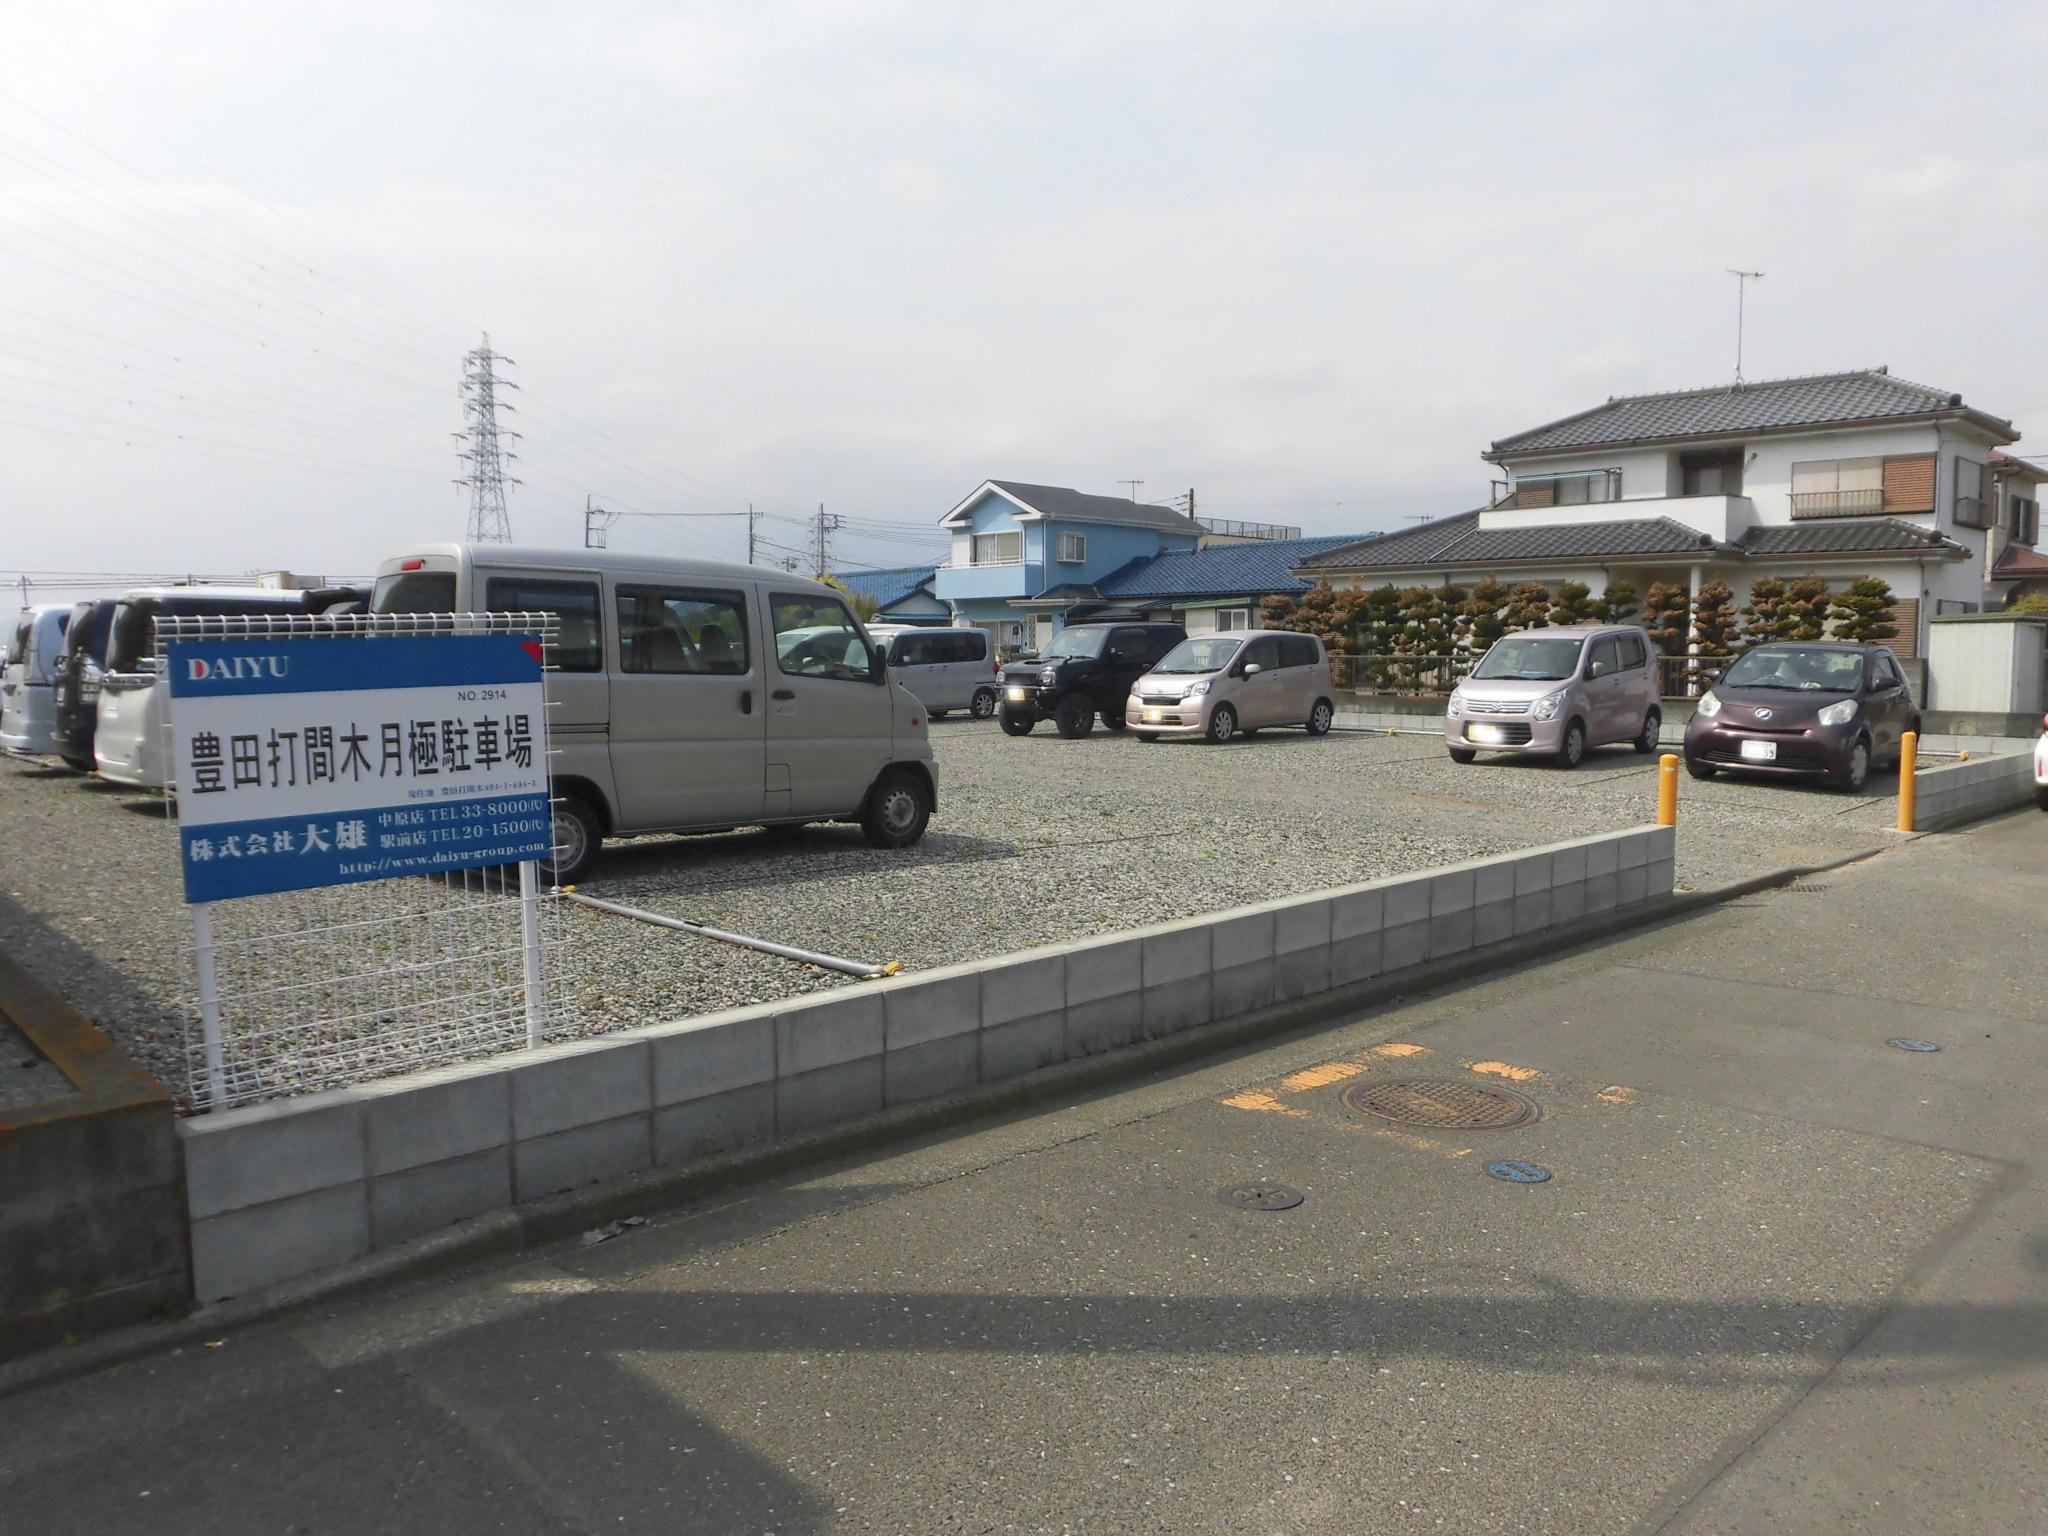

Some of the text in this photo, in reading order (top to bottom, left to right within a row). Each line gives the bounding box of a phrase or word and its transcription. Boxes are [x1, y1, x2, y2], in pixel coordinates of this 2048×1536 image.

[186, 656, 289, 681] DAIYU
[190, 714, 533, 794] 豊田打間木月極駐車場
[378, 809, 425, 828] 中原店
[428, 807, 459, 822] TEL
[380, 830, 427, 849] 駅前店
[430, 828, 461, 843] TEL
[339, 842, 545, 875] http://www.daiyu-group.com
